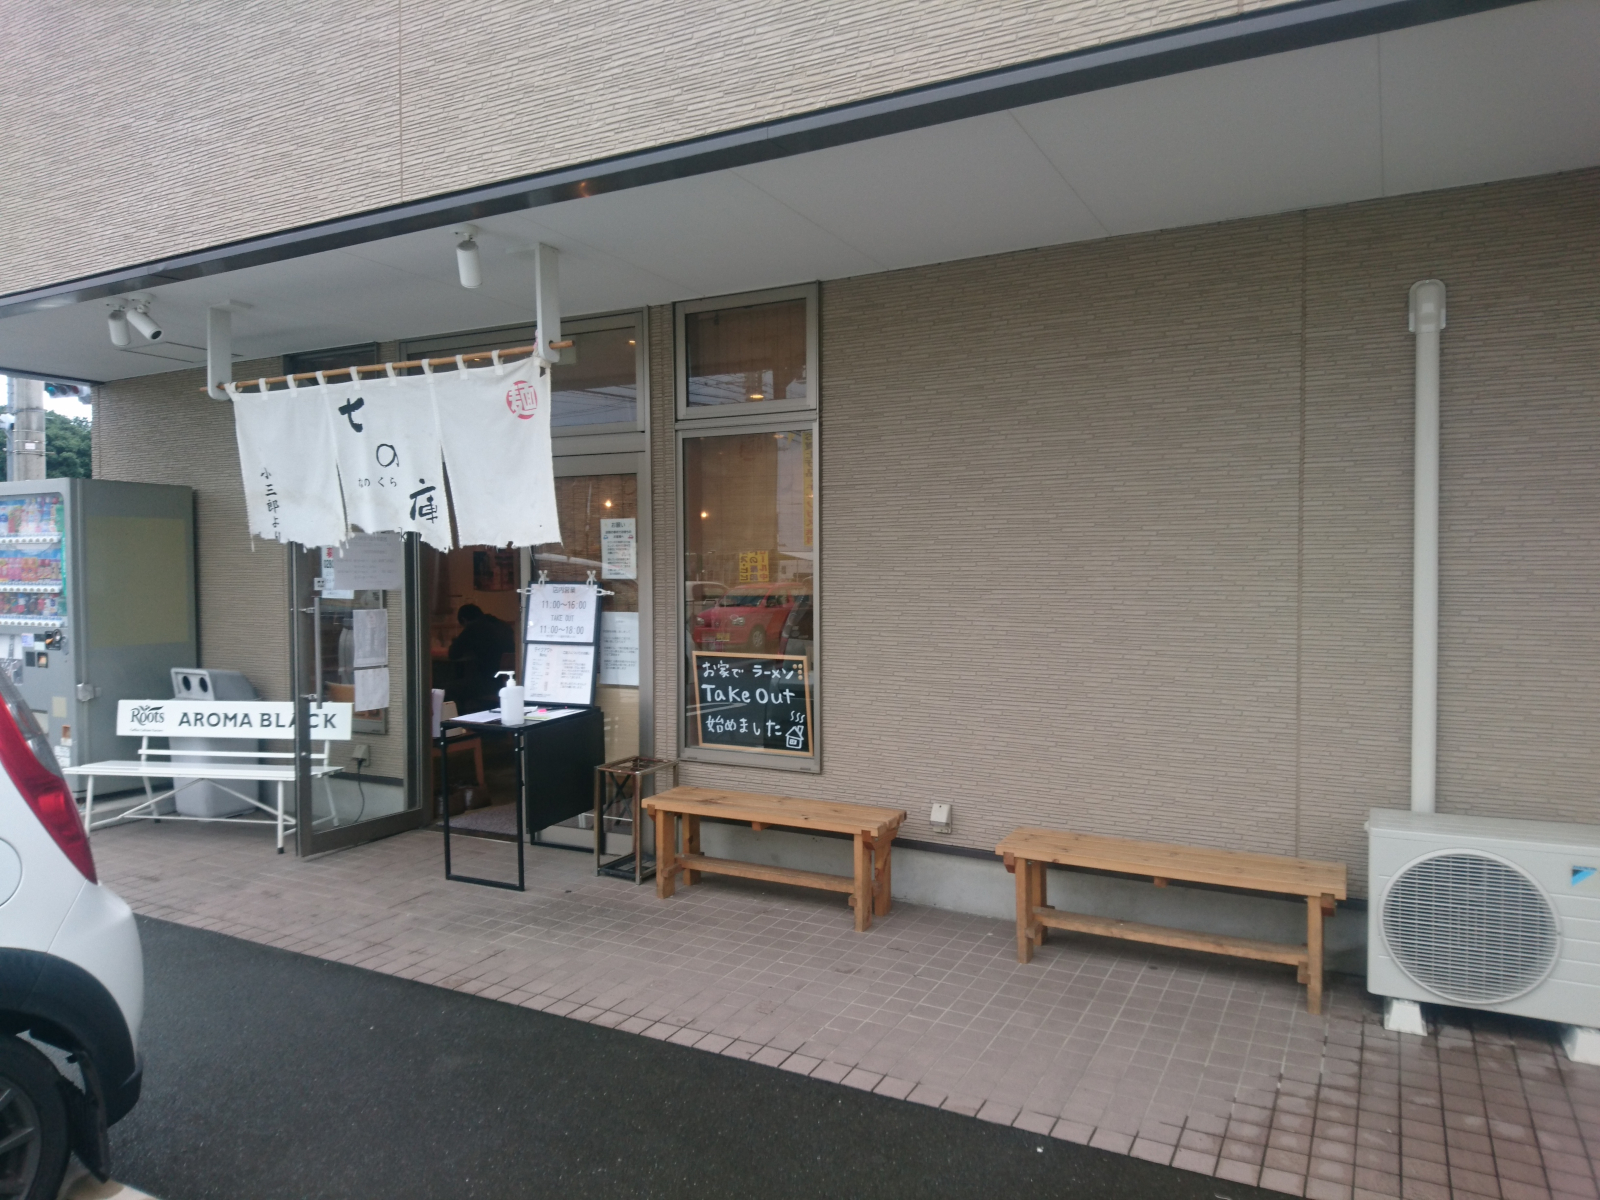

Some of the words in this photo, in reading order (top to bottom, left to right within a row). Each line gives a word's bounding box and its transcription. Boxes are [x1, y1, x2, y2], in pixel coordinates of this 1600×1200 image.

[506, 380, 538, 419] 麺
[702, 660, 744, 678] お家で
[752, 665, 794, 679] ラーメン
[701, 684, 750, 703] Take
[755, 688, 795, 704] Out
[130, 705, 165, 726] Roots
[178, 712, 253, 728] AROMA
[705, 715, 783, 737] 始めました
